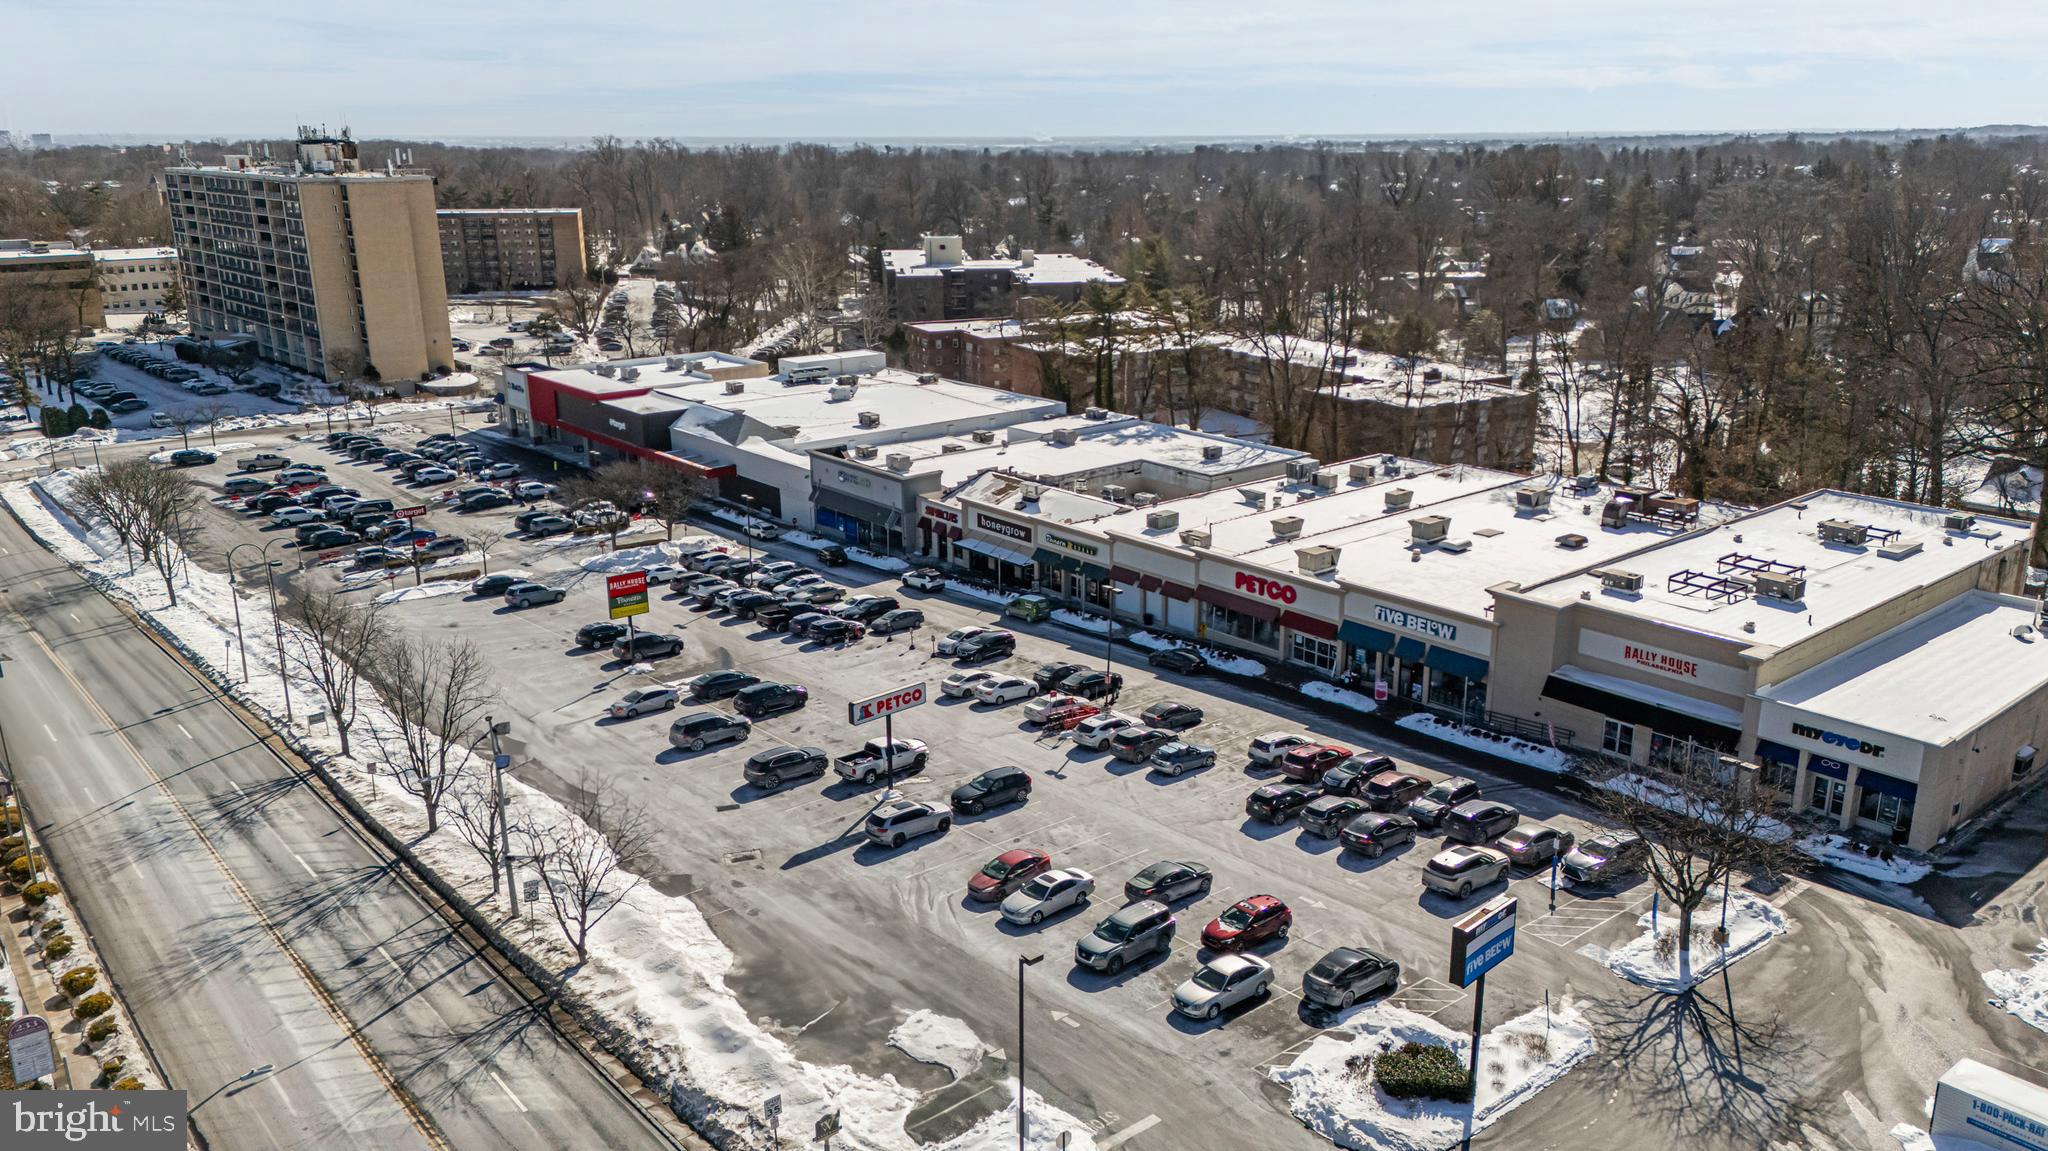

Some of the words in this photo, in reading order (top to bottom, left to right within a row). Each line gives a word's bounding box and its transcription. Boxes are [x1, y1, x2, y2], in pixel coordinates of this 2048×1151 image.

[404, 507, 425, 516] target
[981, 516, 1026, 537] honeygrow
[1235, 571, 1297, 604] PETCO
[1374, 606, 1405, 626] five
[1406, 614, 1455, 640] BELOW
[1624, 645, 1658, 661] RALLY
[1661, 655, 1698, 678] HOUSE
[1636, 659, 1684, 675] PHILADELPHIA
[876, 688, 922, 714] PETCO
[1466, 953, 1485, 976] five
[1485, 934, 1513, 962] BELOW
[767, 1105, 780, 1117] 35
[1972, 1100, 2047, 1137] 1-800-PACK-RAT
